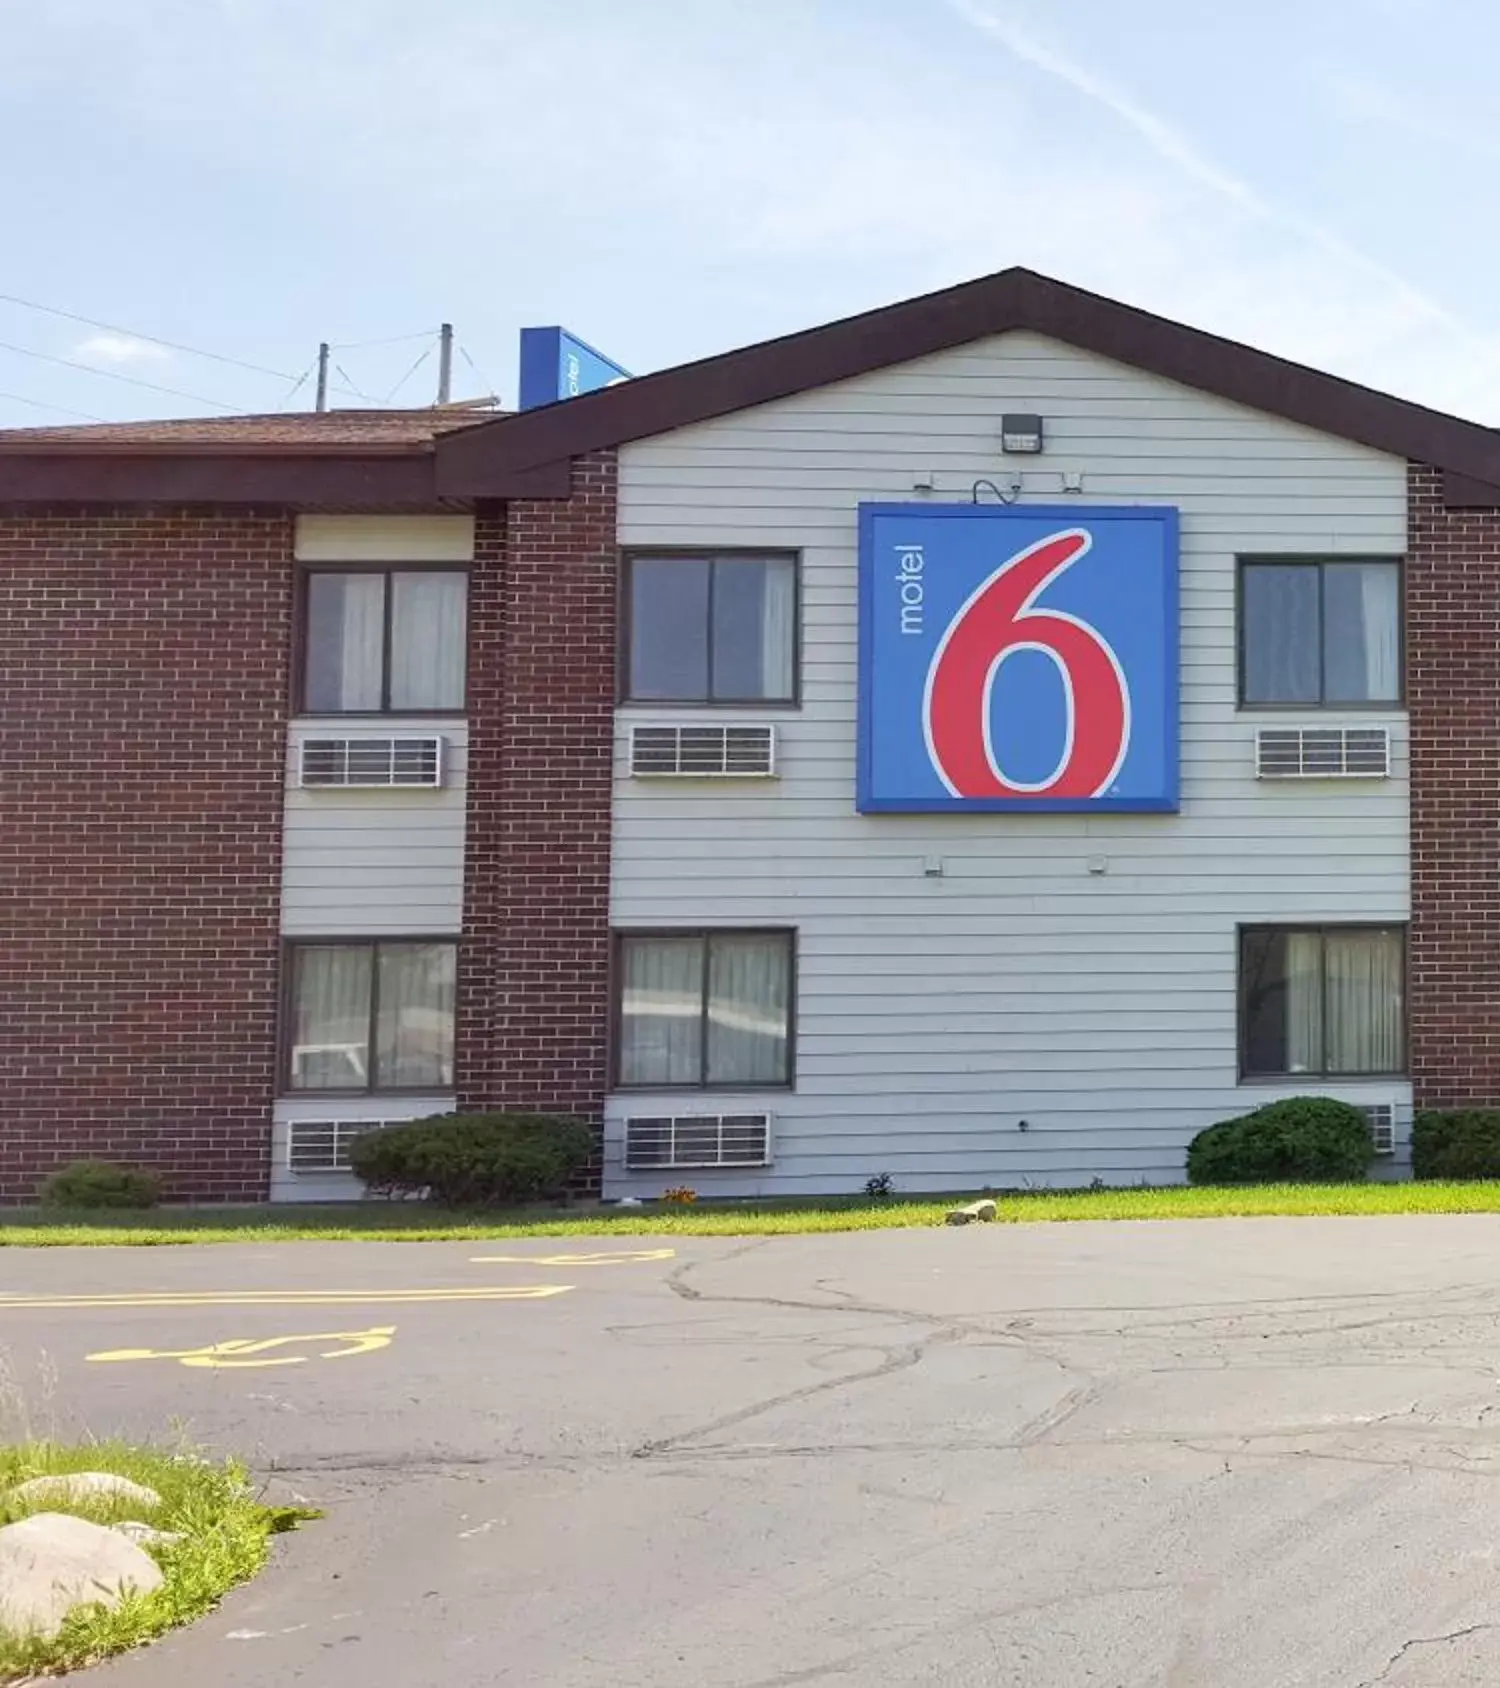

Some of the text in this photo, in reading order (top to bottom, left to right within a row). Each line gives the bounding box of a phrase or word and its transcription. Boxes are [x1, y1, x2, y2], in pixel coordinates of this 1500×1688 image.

[568, 353, 579, 396] otel
[894, 545, 923, 634] motel
[922, 527, 1132, 798] 6
